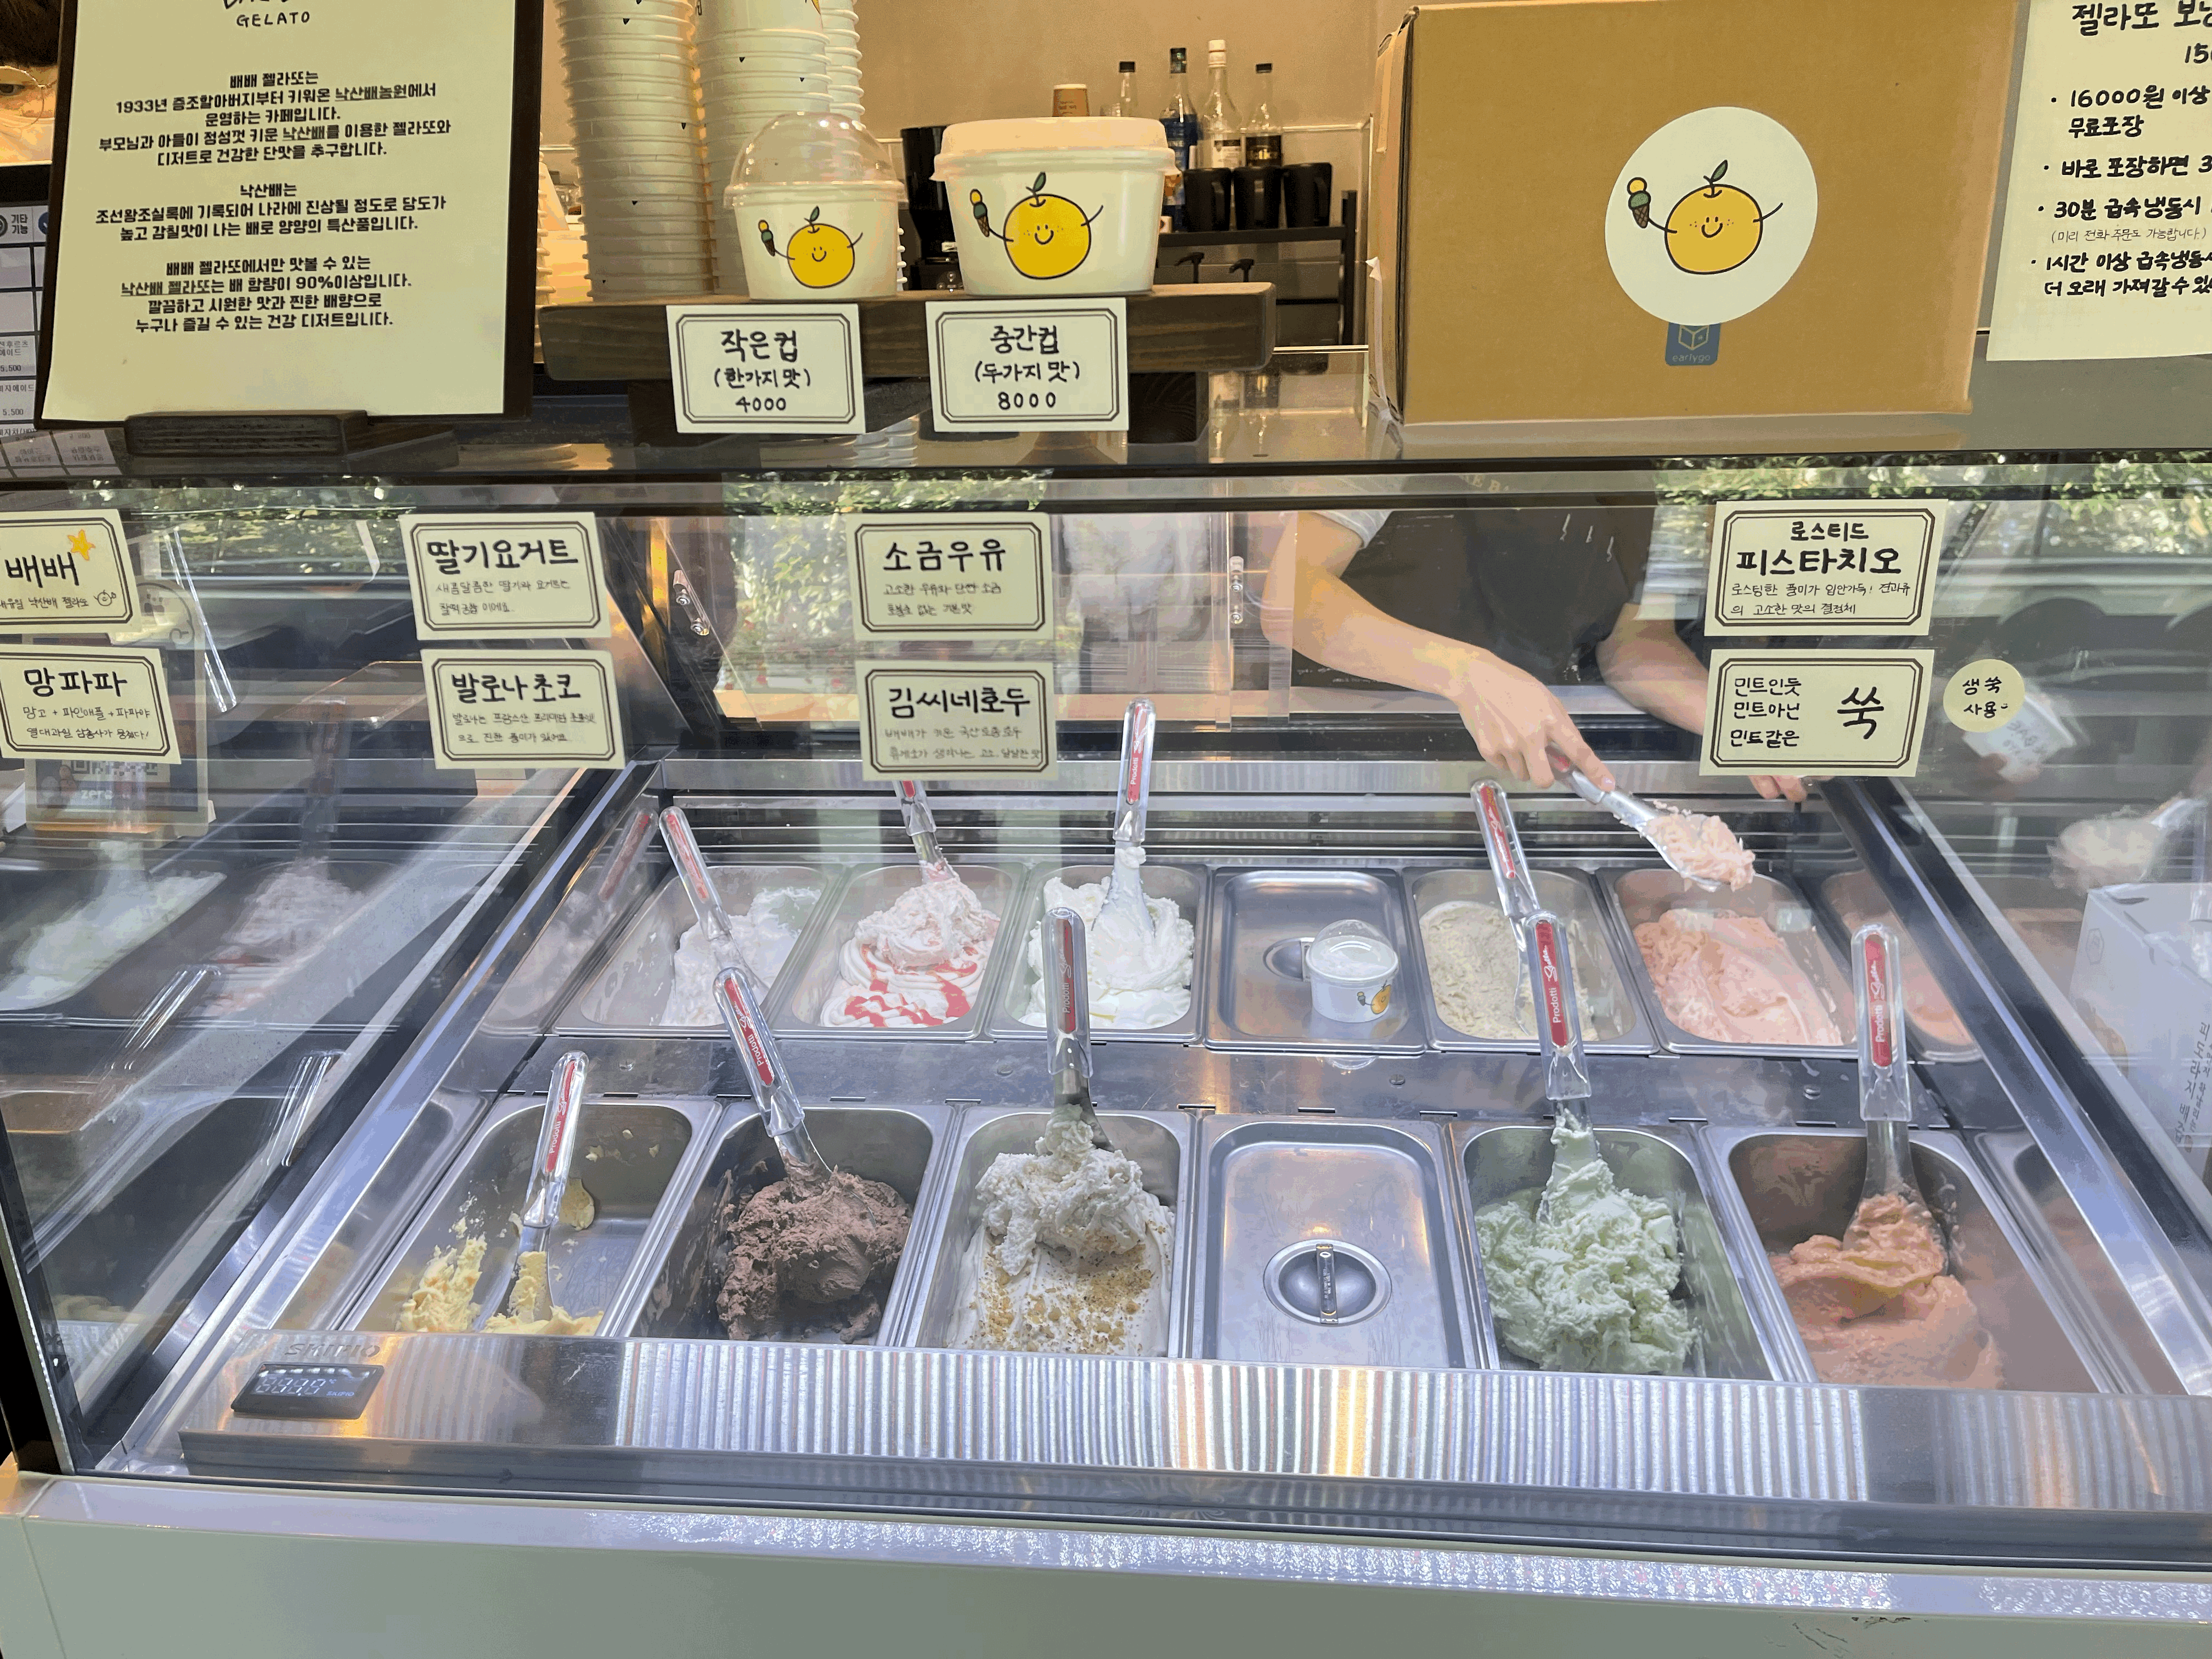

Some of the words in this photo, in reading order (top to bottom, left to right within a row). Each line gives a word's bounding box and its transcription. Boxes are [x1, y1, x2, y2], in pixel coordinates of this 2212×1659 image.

[236, 11, 309, 27] GELATO
[2072, 2, 2159, 36] 젤라또
[230, 75, 257, 89] 배배
[263, 71, 319, 87] 젤라또는
[116, 98, 167, 114] 1933년
[173, 91, 283, 111] 증조할아버지부터
[287, 88, 330, 103] 키워온
[2070, 84, 2165, 109] 16000원
[2171, 86, 2210, 105] 이상
[205, 111, 261, 127] 운영하는
[266, 106, 341, 123] 카페입니다.
[2068, 115, 2144, 138] 무료포장
[99, 135, 154, 151] 부모님과
[158, 132, 199, 148] 아들이
[204, 129, 245, 146] 정성껏
[250, 127, 278, 143] 키운
[283, 125, 340, 142] 낙산배를
[345, 122, 388, 138] 이용한
[393, 120, 452, 137] 젤라또와
[157, 149, 212, 166] 디저트로
[217, 147, 259, 163] 건강한
[263, 144, 306, 160] 단맛을
[311, 141, 387, 159] 추구합니다.
[2062, 159, 2102, 179] 바로
[2108, 155, 2190, 178] 포장하면
[240, 183, 297, 199] 낙산배는
[95, 205, 194, 224] 조선왕조실록에
[198, 202, 253, 219] 기록되어
[259, 200, 301, 216] 나라에
[306, 198, 349, 215] 진상될
[354, 196, 397, 213] 정도로
[2053, 199, 2097, 220] 30분
[11, 224, 29, 235] 기능
[120, 225, 148, 241] 높고
[152, 223, 208, 240] 감칠맛이
[213, 222, 241, 237] 나는
[246, 220, 274, 235] 배로
[279, 218, 321, 235] 양양의
[326, 215, 419, 233] 특산품입니다.
[166, 262, 194, 276] 배배
[199, 258, 285, 275] 젤라또에서만
[290, 257, 318, 272] 맛볼
[323, 256, 337, 270] 수
[342, 255, 371, 270] 있는
[2046, 252, 2089, 273] 1시간
[2096, 252, 2132, 272] 이상
[120, 281, 163, 297] 낙산배
[168, 279, 225, 295] 젤라또는
[229, 278, 243, 292] 배
[248, 275, 290, 292] 함량이
[296, 273, 413, 290] 90%이상입니다.
[2044, 280, 2061, 297] 더
[2067, 278, 2106, 297] 오래
[148, 298, 205, 314] 깔끔하고
[208, 296, 252, 312] 시원한
[257, 296, 285, 311] 맛과
[324, 292, 382, 309] 배향으로
[136, 317, 178, 333] 누구나
[183, 316, 210, 332] 즐길
[215, 316, 229, 330] 수
[234, 315, 263, 330] 있는
[268, 313, 297, 329] 건강
[302, 311, 393, 328] 디저트입니다.
[735, 396, 787, 413] 4000
[997, 391, 1057, 410] 8000
[1790, 521, 1869, 541] 로스티드
[426, 539, 579, 575] 딸기요거트
[883, 539, 1006, 573] 소금우유
[1736, 548, 1902, 577] 피스타치오
[4, 551, 80, 589] 배배
[1731, 583, 1778, 597] 로스팅한
[1785, 583, 1820, 597] 풍미가
[1730, 605, 1743, 616] 의
[24, 667, 128, 697] 망파파
[22, 707, 47, 720] 망고
[889, 687, 1031, 718] 김씨네호두
[1734, 701, 1801, 721] 민트아닌
[1837, 686, 1884, 741] 쑥
[1730, 729, 1800, 749] 민트같은
[1549, 987, 1562, 1023] Prodotti
